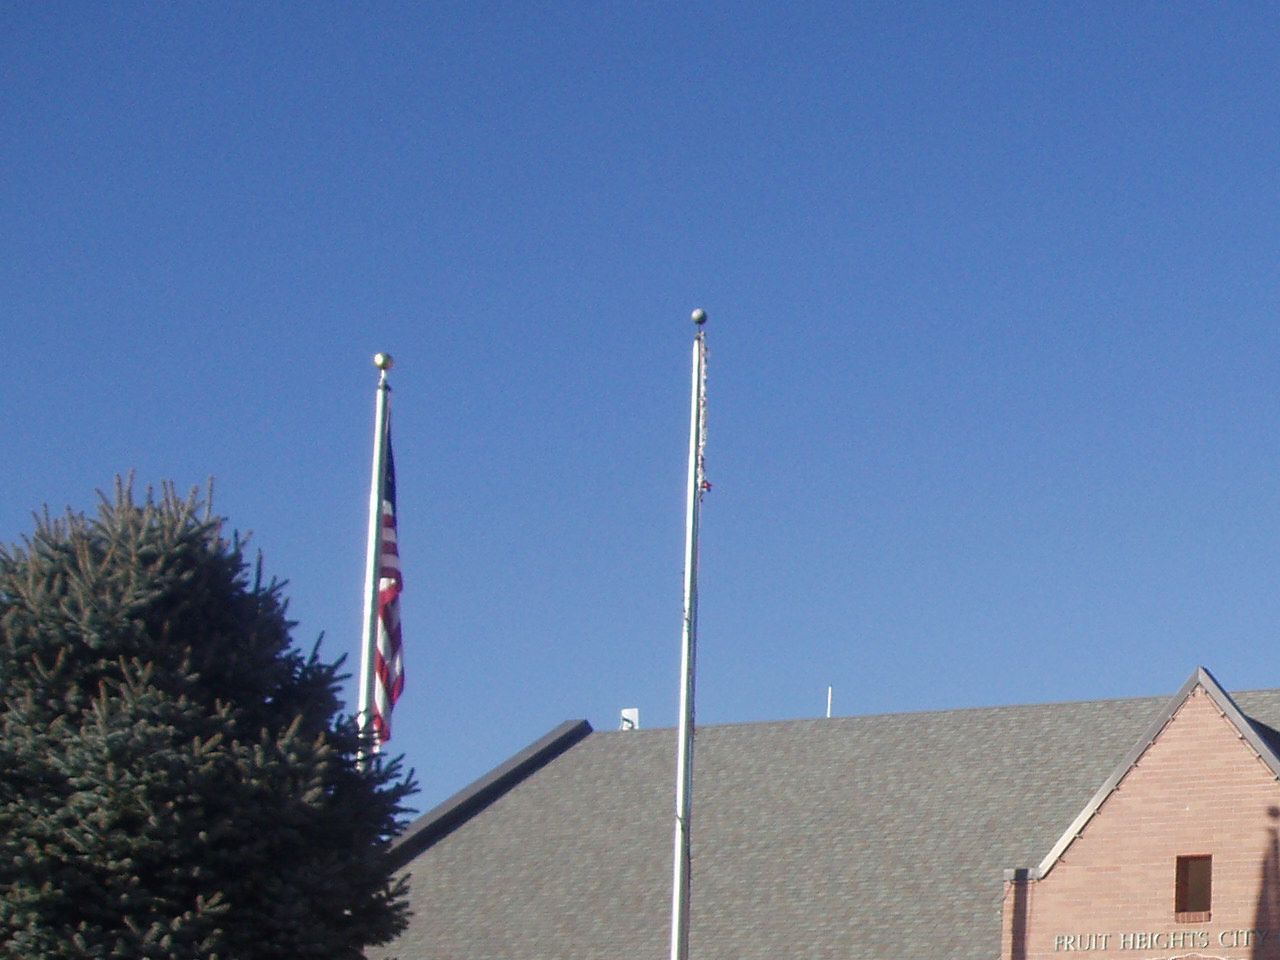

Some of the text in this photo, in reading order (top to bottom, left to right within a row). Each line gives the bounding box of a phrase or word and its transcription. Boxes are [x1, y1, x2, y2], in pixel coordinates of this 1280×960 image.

[1054, 934, 1113, 953] FRUIT
[1119, 931, 1210, 950] HEIGHTS
[1218, 928, 1269, 948] CITY
